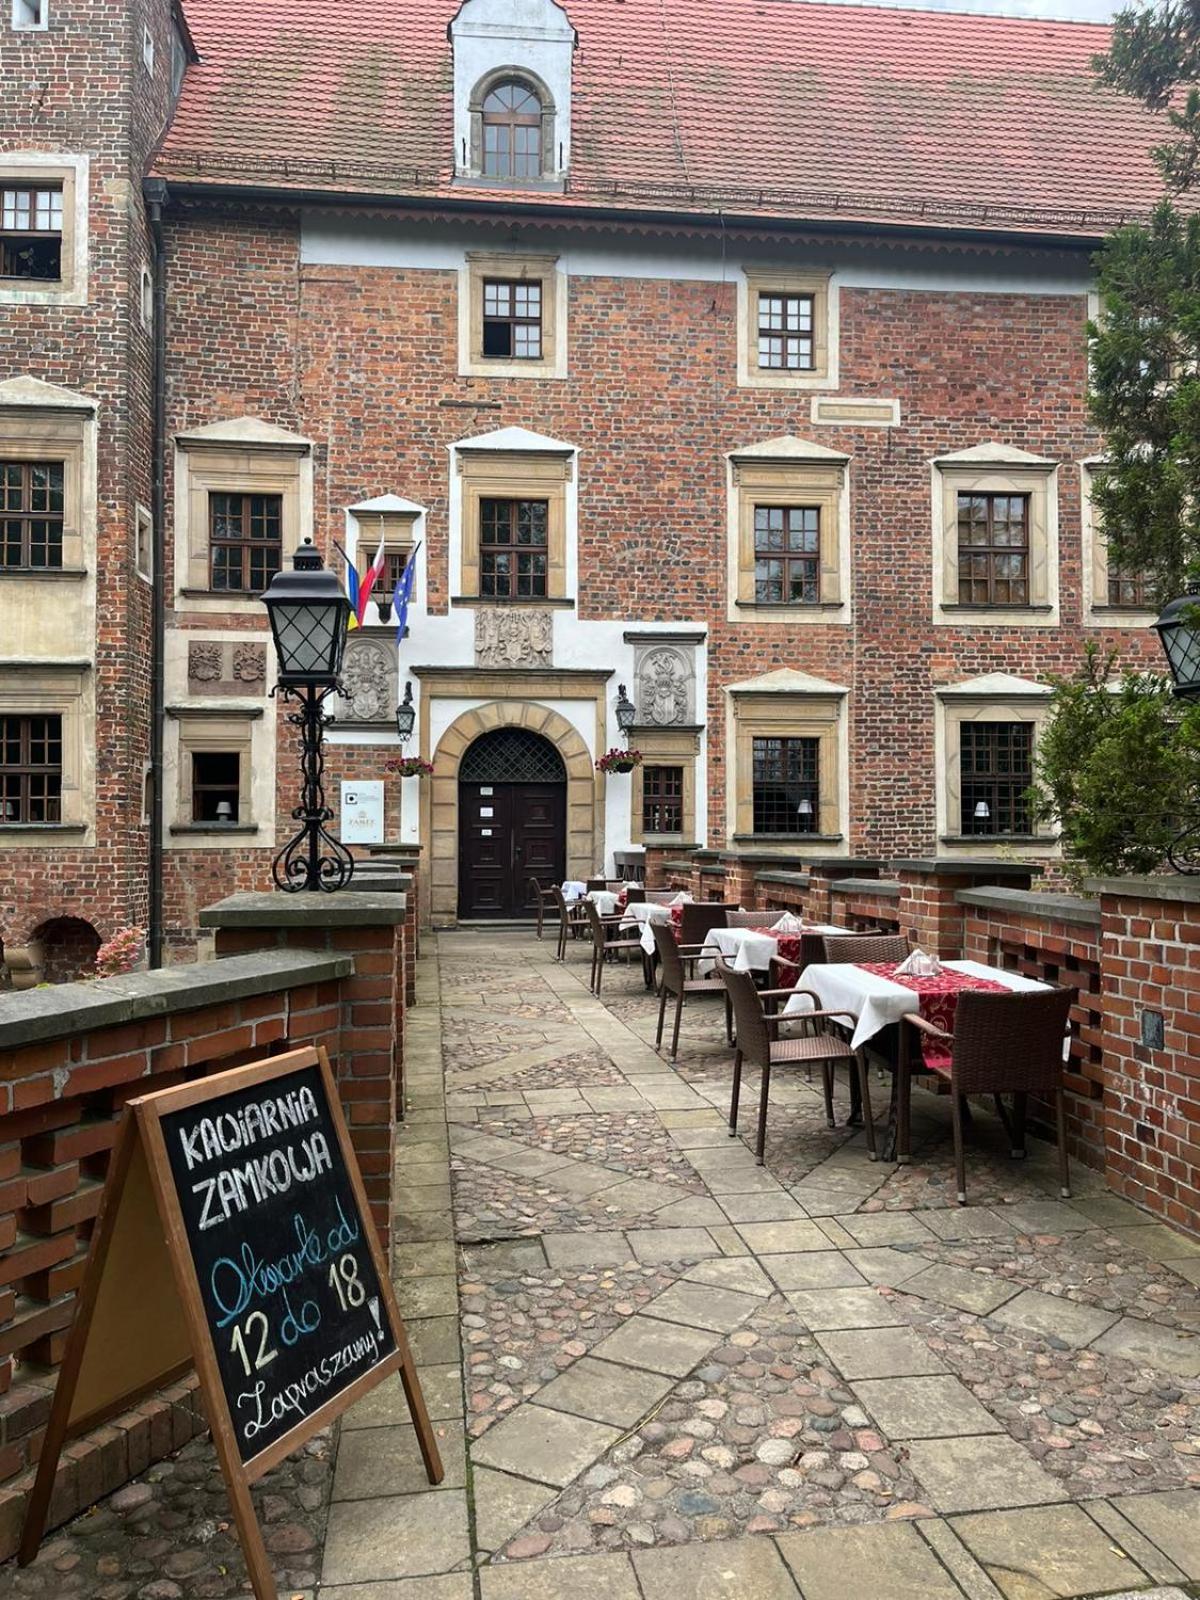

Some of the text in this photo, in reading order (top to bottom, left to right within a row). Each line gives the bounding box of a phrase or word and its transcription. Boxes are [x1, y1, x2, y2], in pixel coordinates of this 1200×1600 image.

[192, 1131, 333, 1231] ZAMKOWA
[212, 1195, 359, 1327] Otwarte od
[230, 1254, 365, 1376] 12 do 18
[237, 1296, 385, 1439] Zapraszamy!
